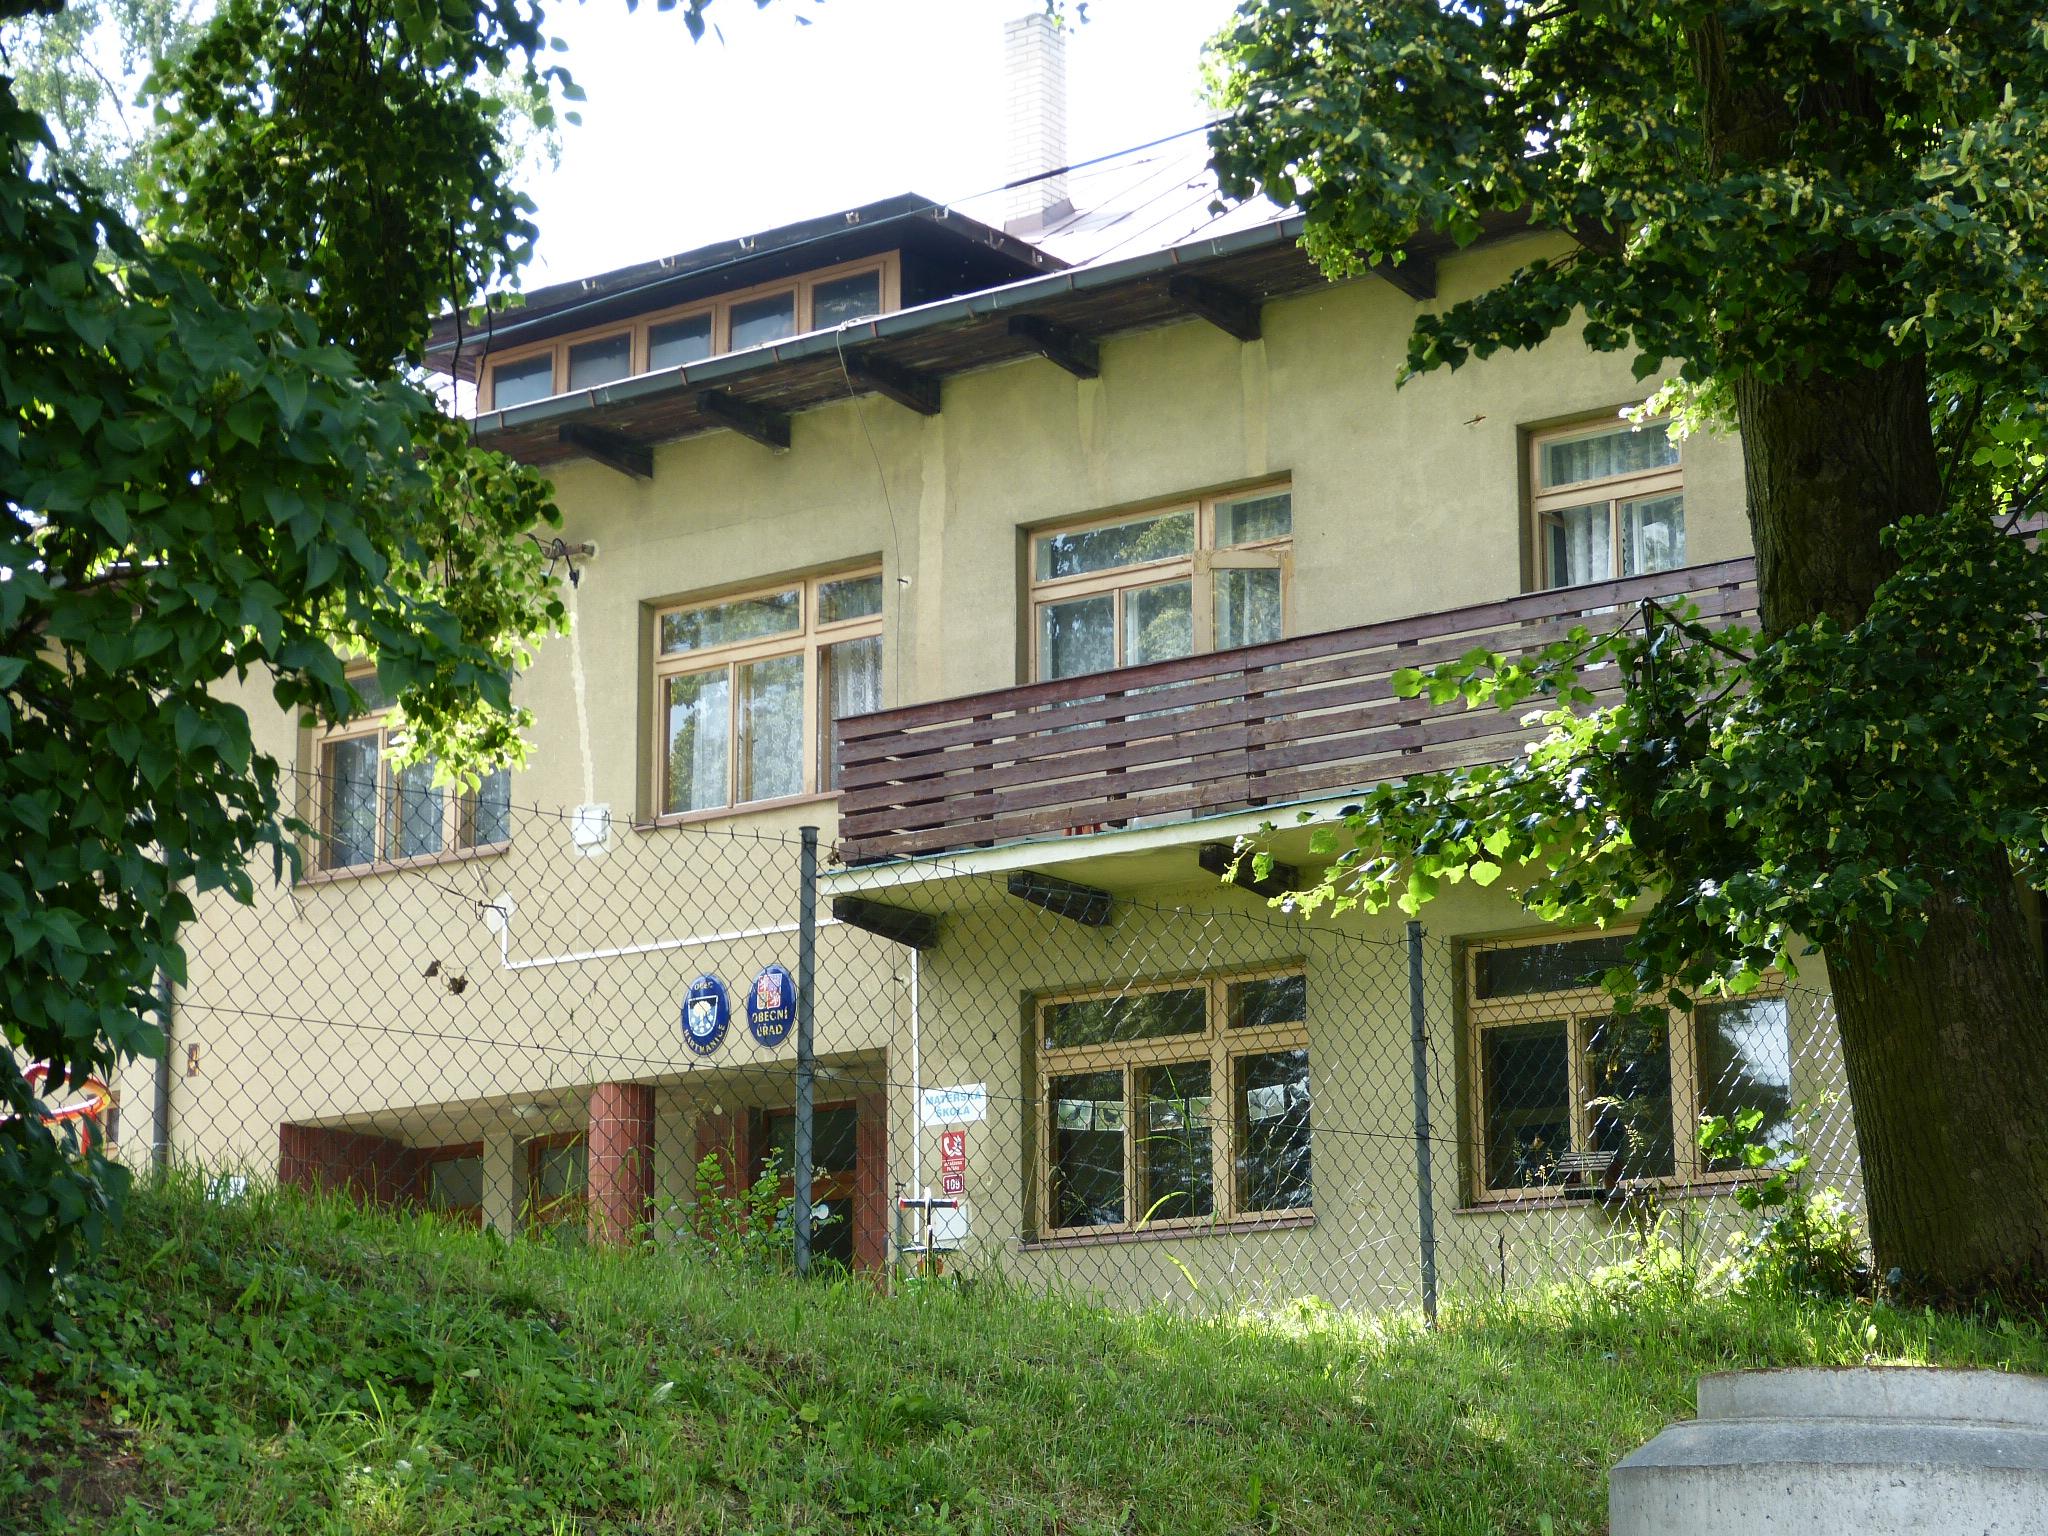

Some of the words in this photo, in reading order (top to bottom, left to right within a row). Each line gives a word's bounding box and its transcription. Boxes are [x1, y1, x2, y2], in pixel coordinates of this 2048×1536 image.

[752, 1006, 788, 1023] OBECNÍ
[756, 1023, 783, 1037] ÚŘAD
[946, 1179, 960, 1190] 109
